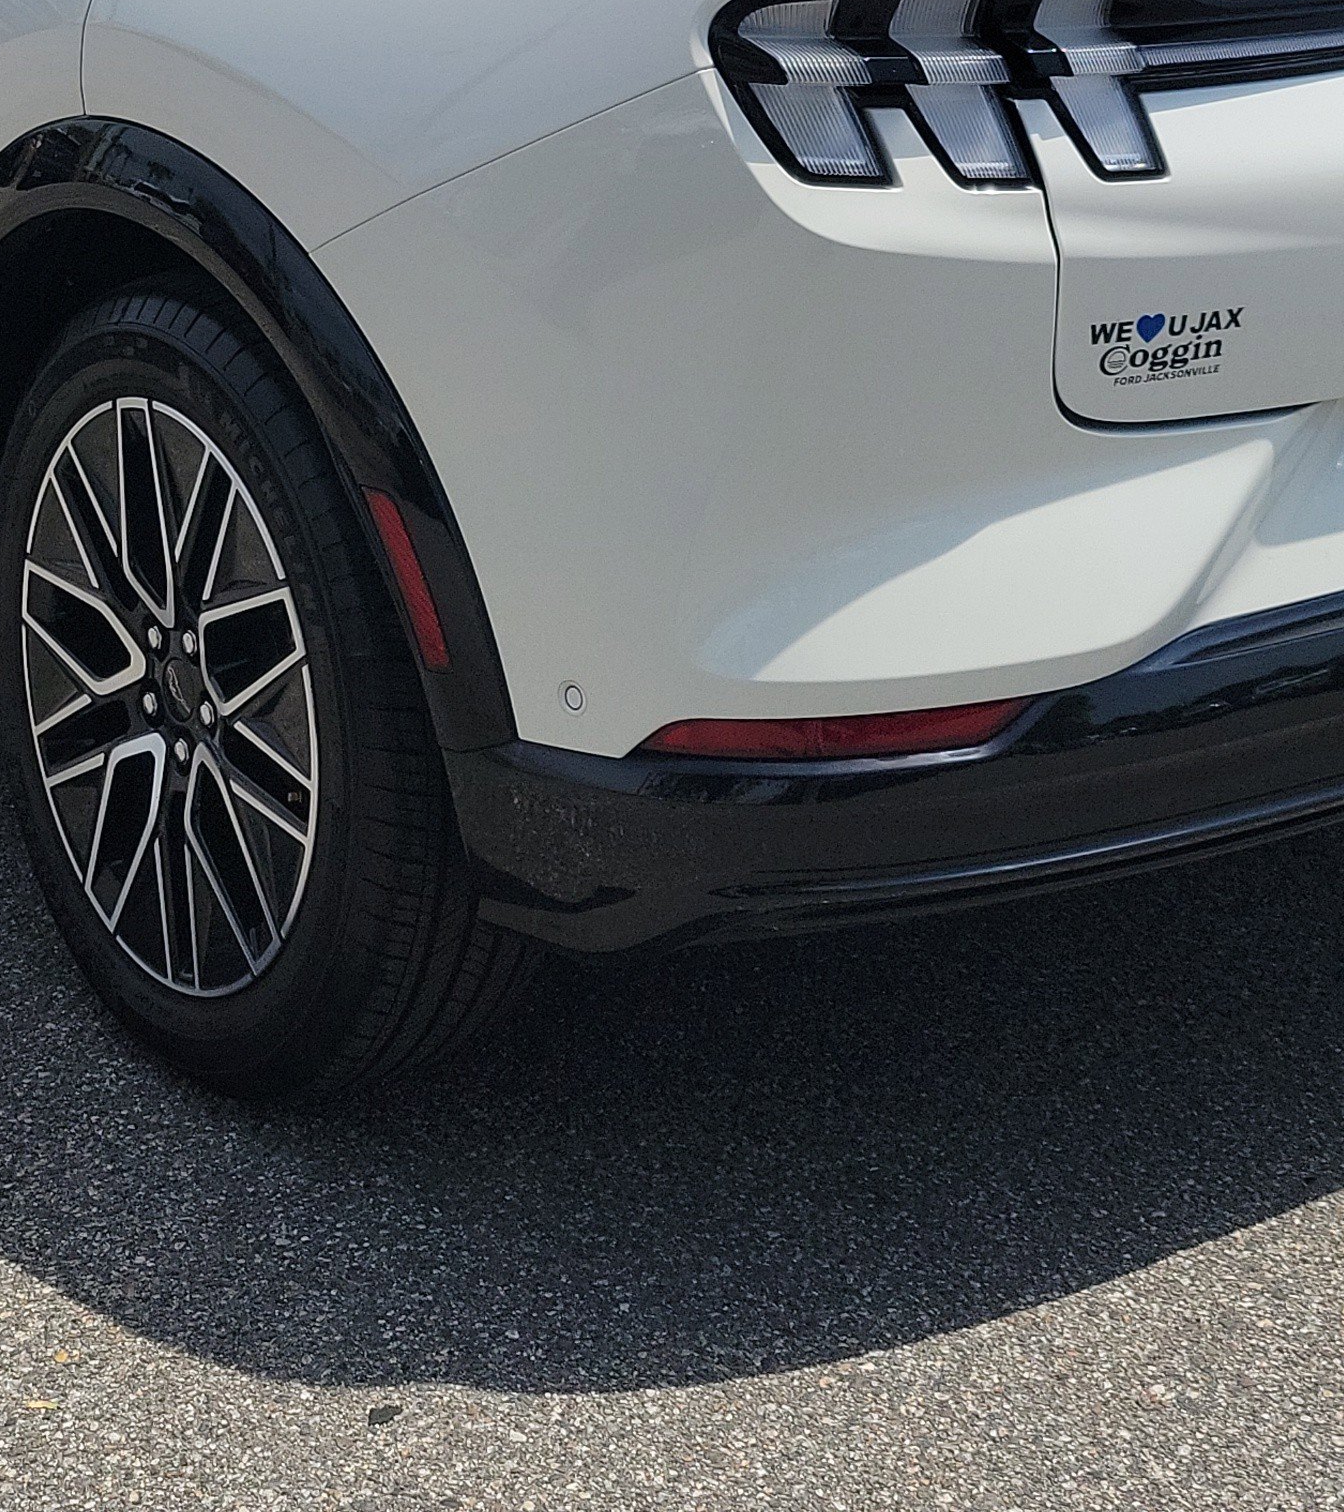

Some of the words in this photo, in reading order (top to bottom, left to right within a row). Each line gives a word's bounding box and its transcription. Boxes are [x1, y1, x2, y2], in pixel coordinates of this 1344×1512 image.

[1090, 320, 1134, 345] WE
[1168, 315, 1188, 336] U
[1190, 306, 1246, 333] JAX
[1099, 334, 1223, 376] Coggin
[1113, 374, 1142, 387] FORD
[1143, 364, 1221, 384] JACKSONVILLE
